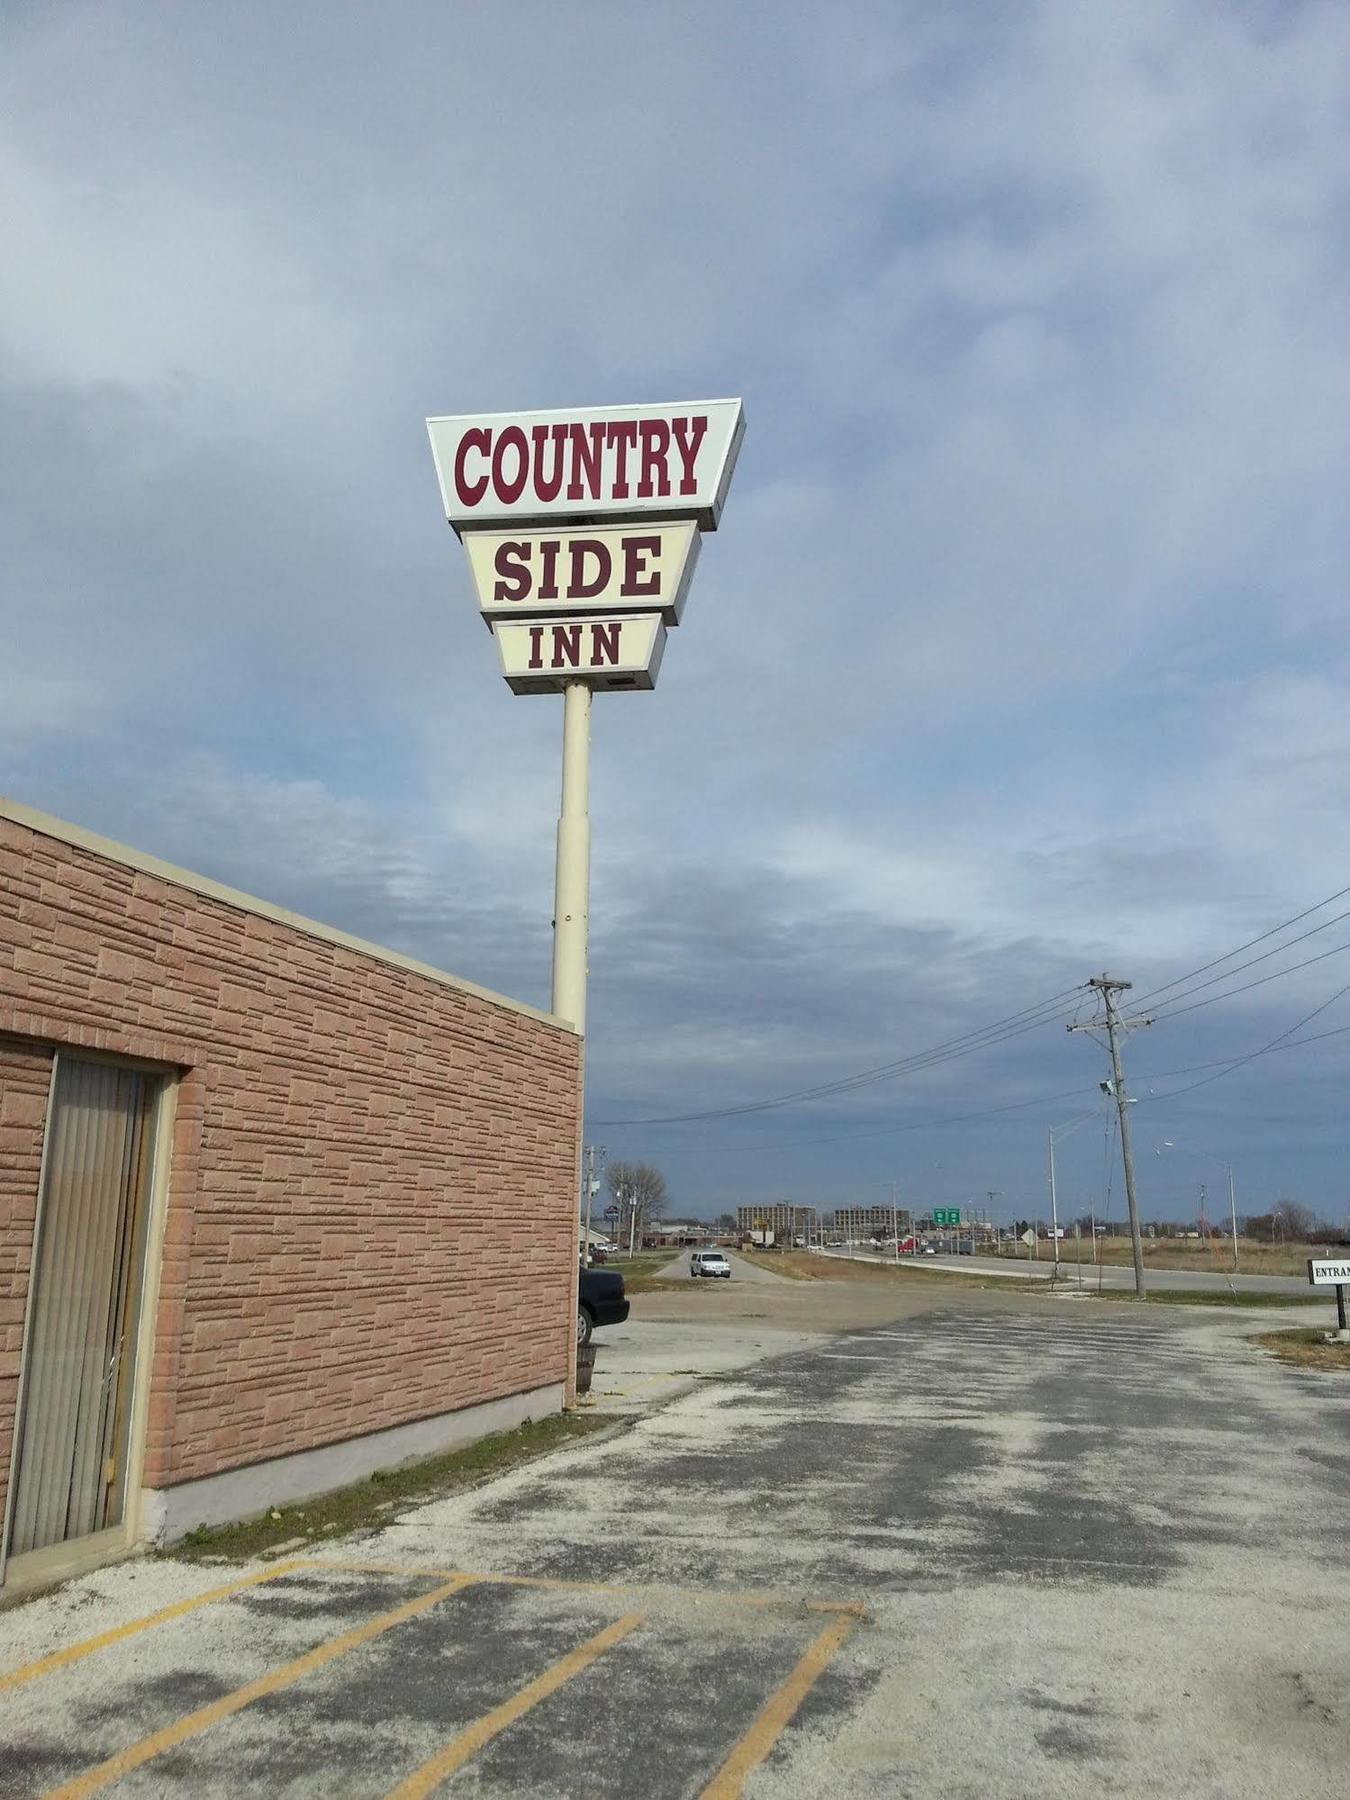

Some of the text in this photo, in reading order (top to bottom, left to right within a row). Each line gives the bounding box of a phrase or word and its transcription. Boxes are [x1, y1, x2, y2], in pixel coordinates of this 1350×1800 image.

[455, 416, 708, 507] COUNTRY
[494, 535, 662, 602] SIDE
[528, 623, 622, 669] INN
